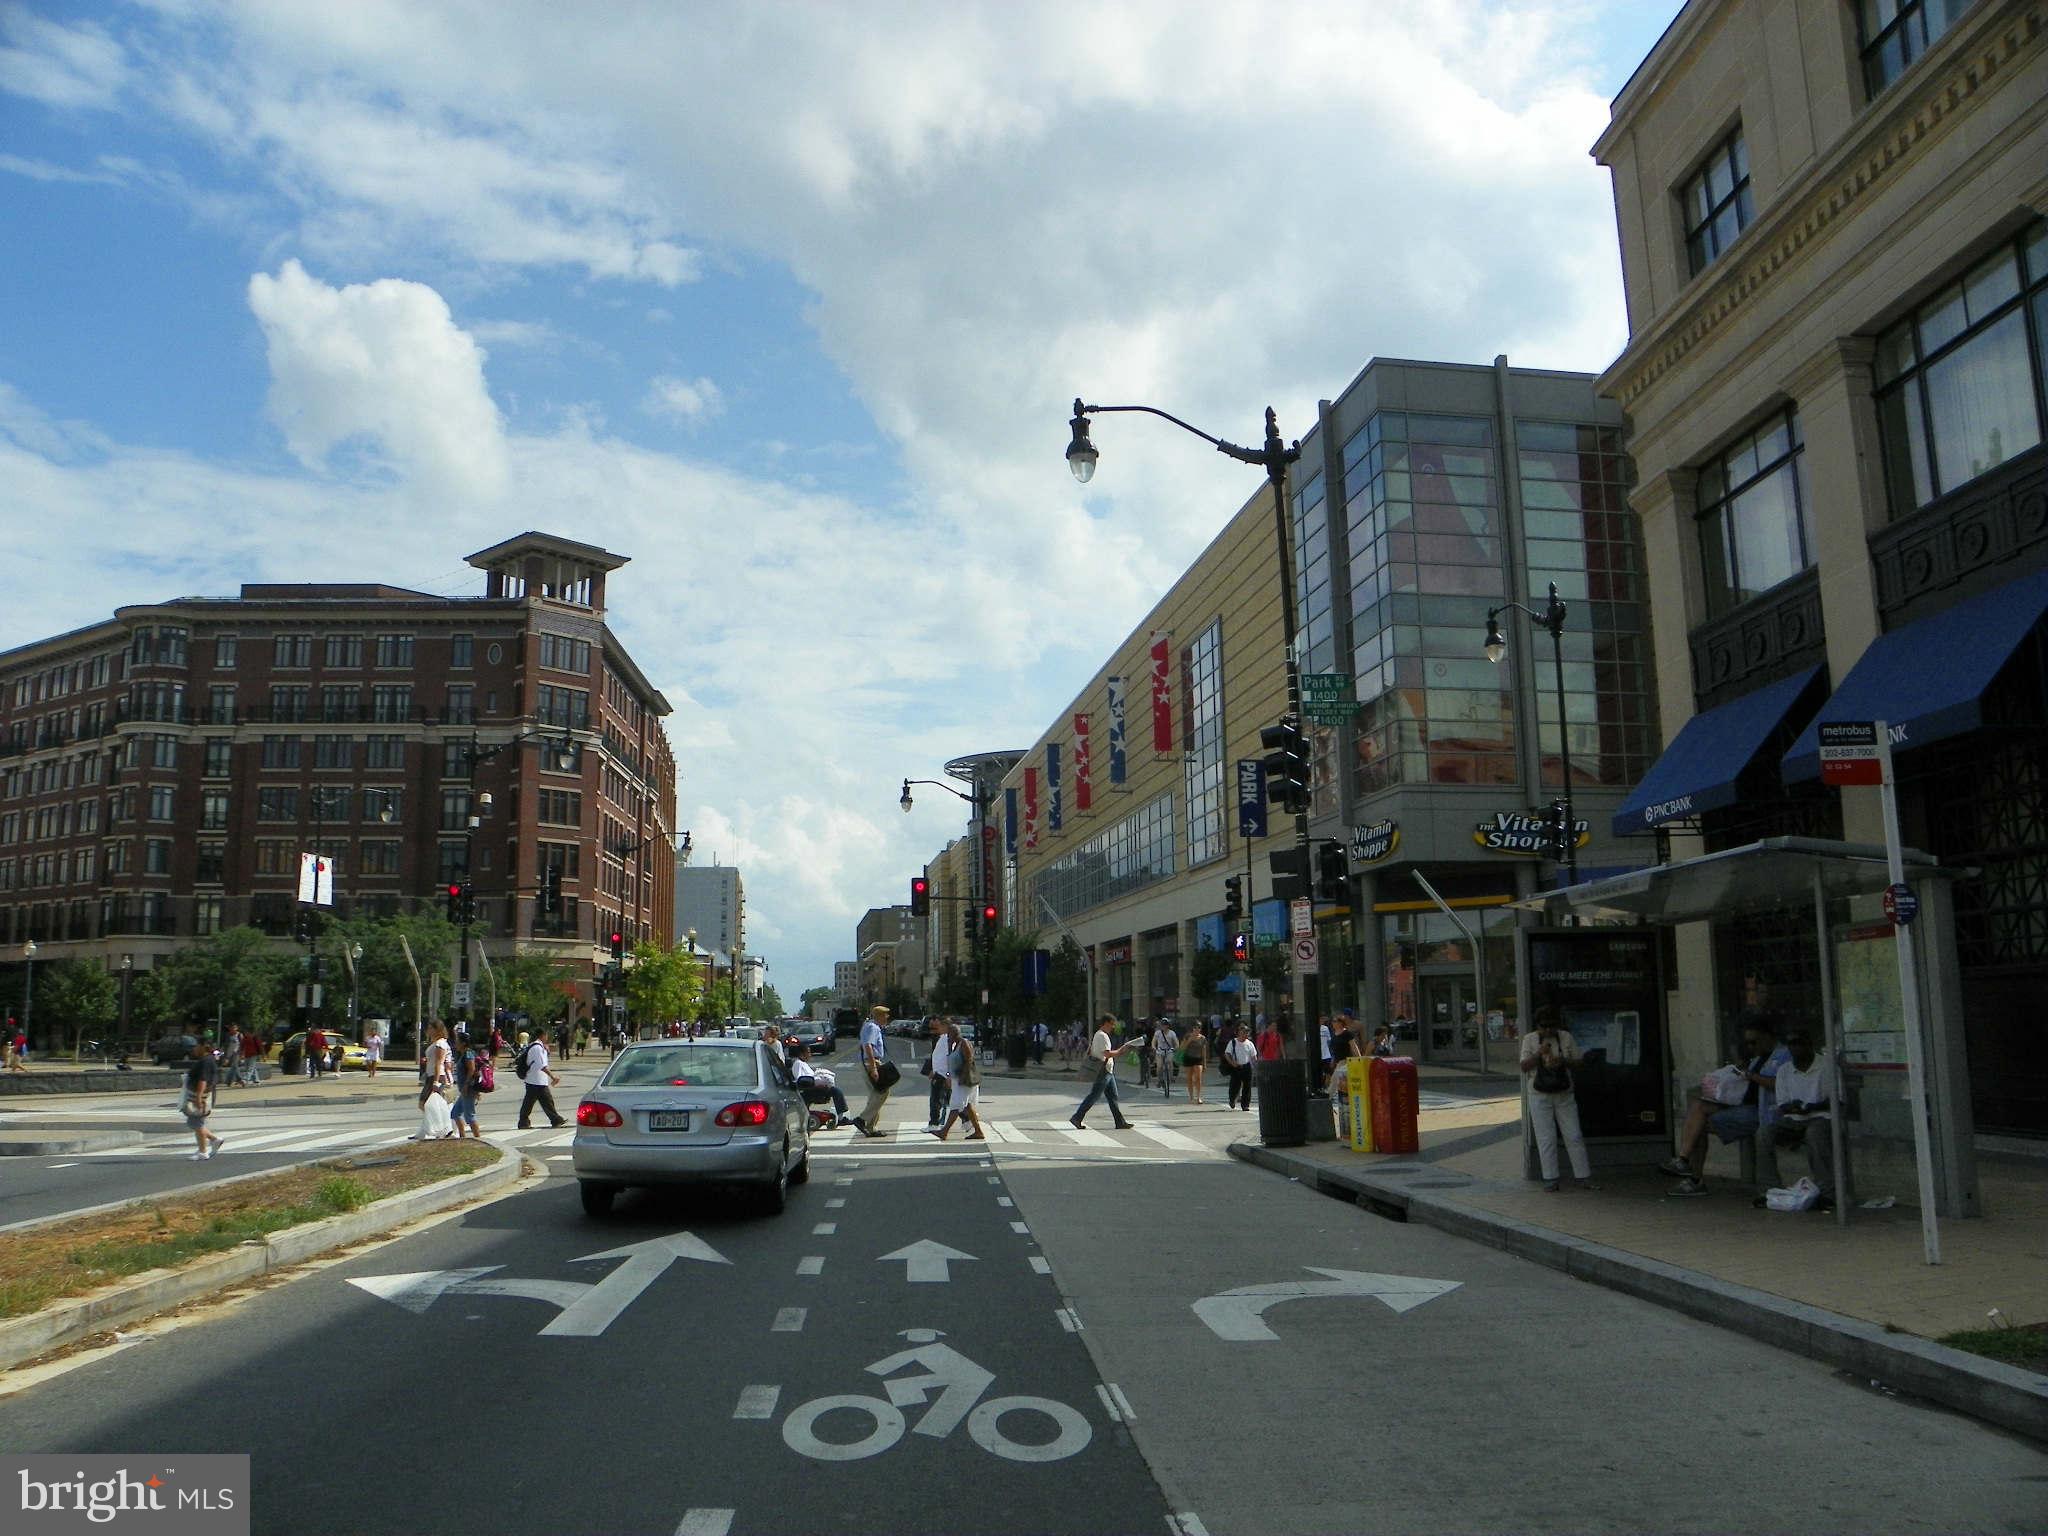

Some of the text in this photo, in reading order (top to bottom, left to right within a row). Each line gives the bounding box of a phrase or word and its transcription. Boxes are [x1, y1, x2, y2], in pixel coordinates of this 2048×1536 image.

[1304, 676, 1331, 688] Park
[1313, 690, 1338, 700] 1400
[1320, 715, 1345, 725] 1400
[1823, 724, 1872, 737] metrobus
[1240, 760, 1258, 805] PARK
[1354, 819, 1392, 843] Vitamin
[1496, 813, 1589, 831] Vitan
[1351, 839, 1388, 861] Shoppe
[1487, 832, 1578, 850] Shop
